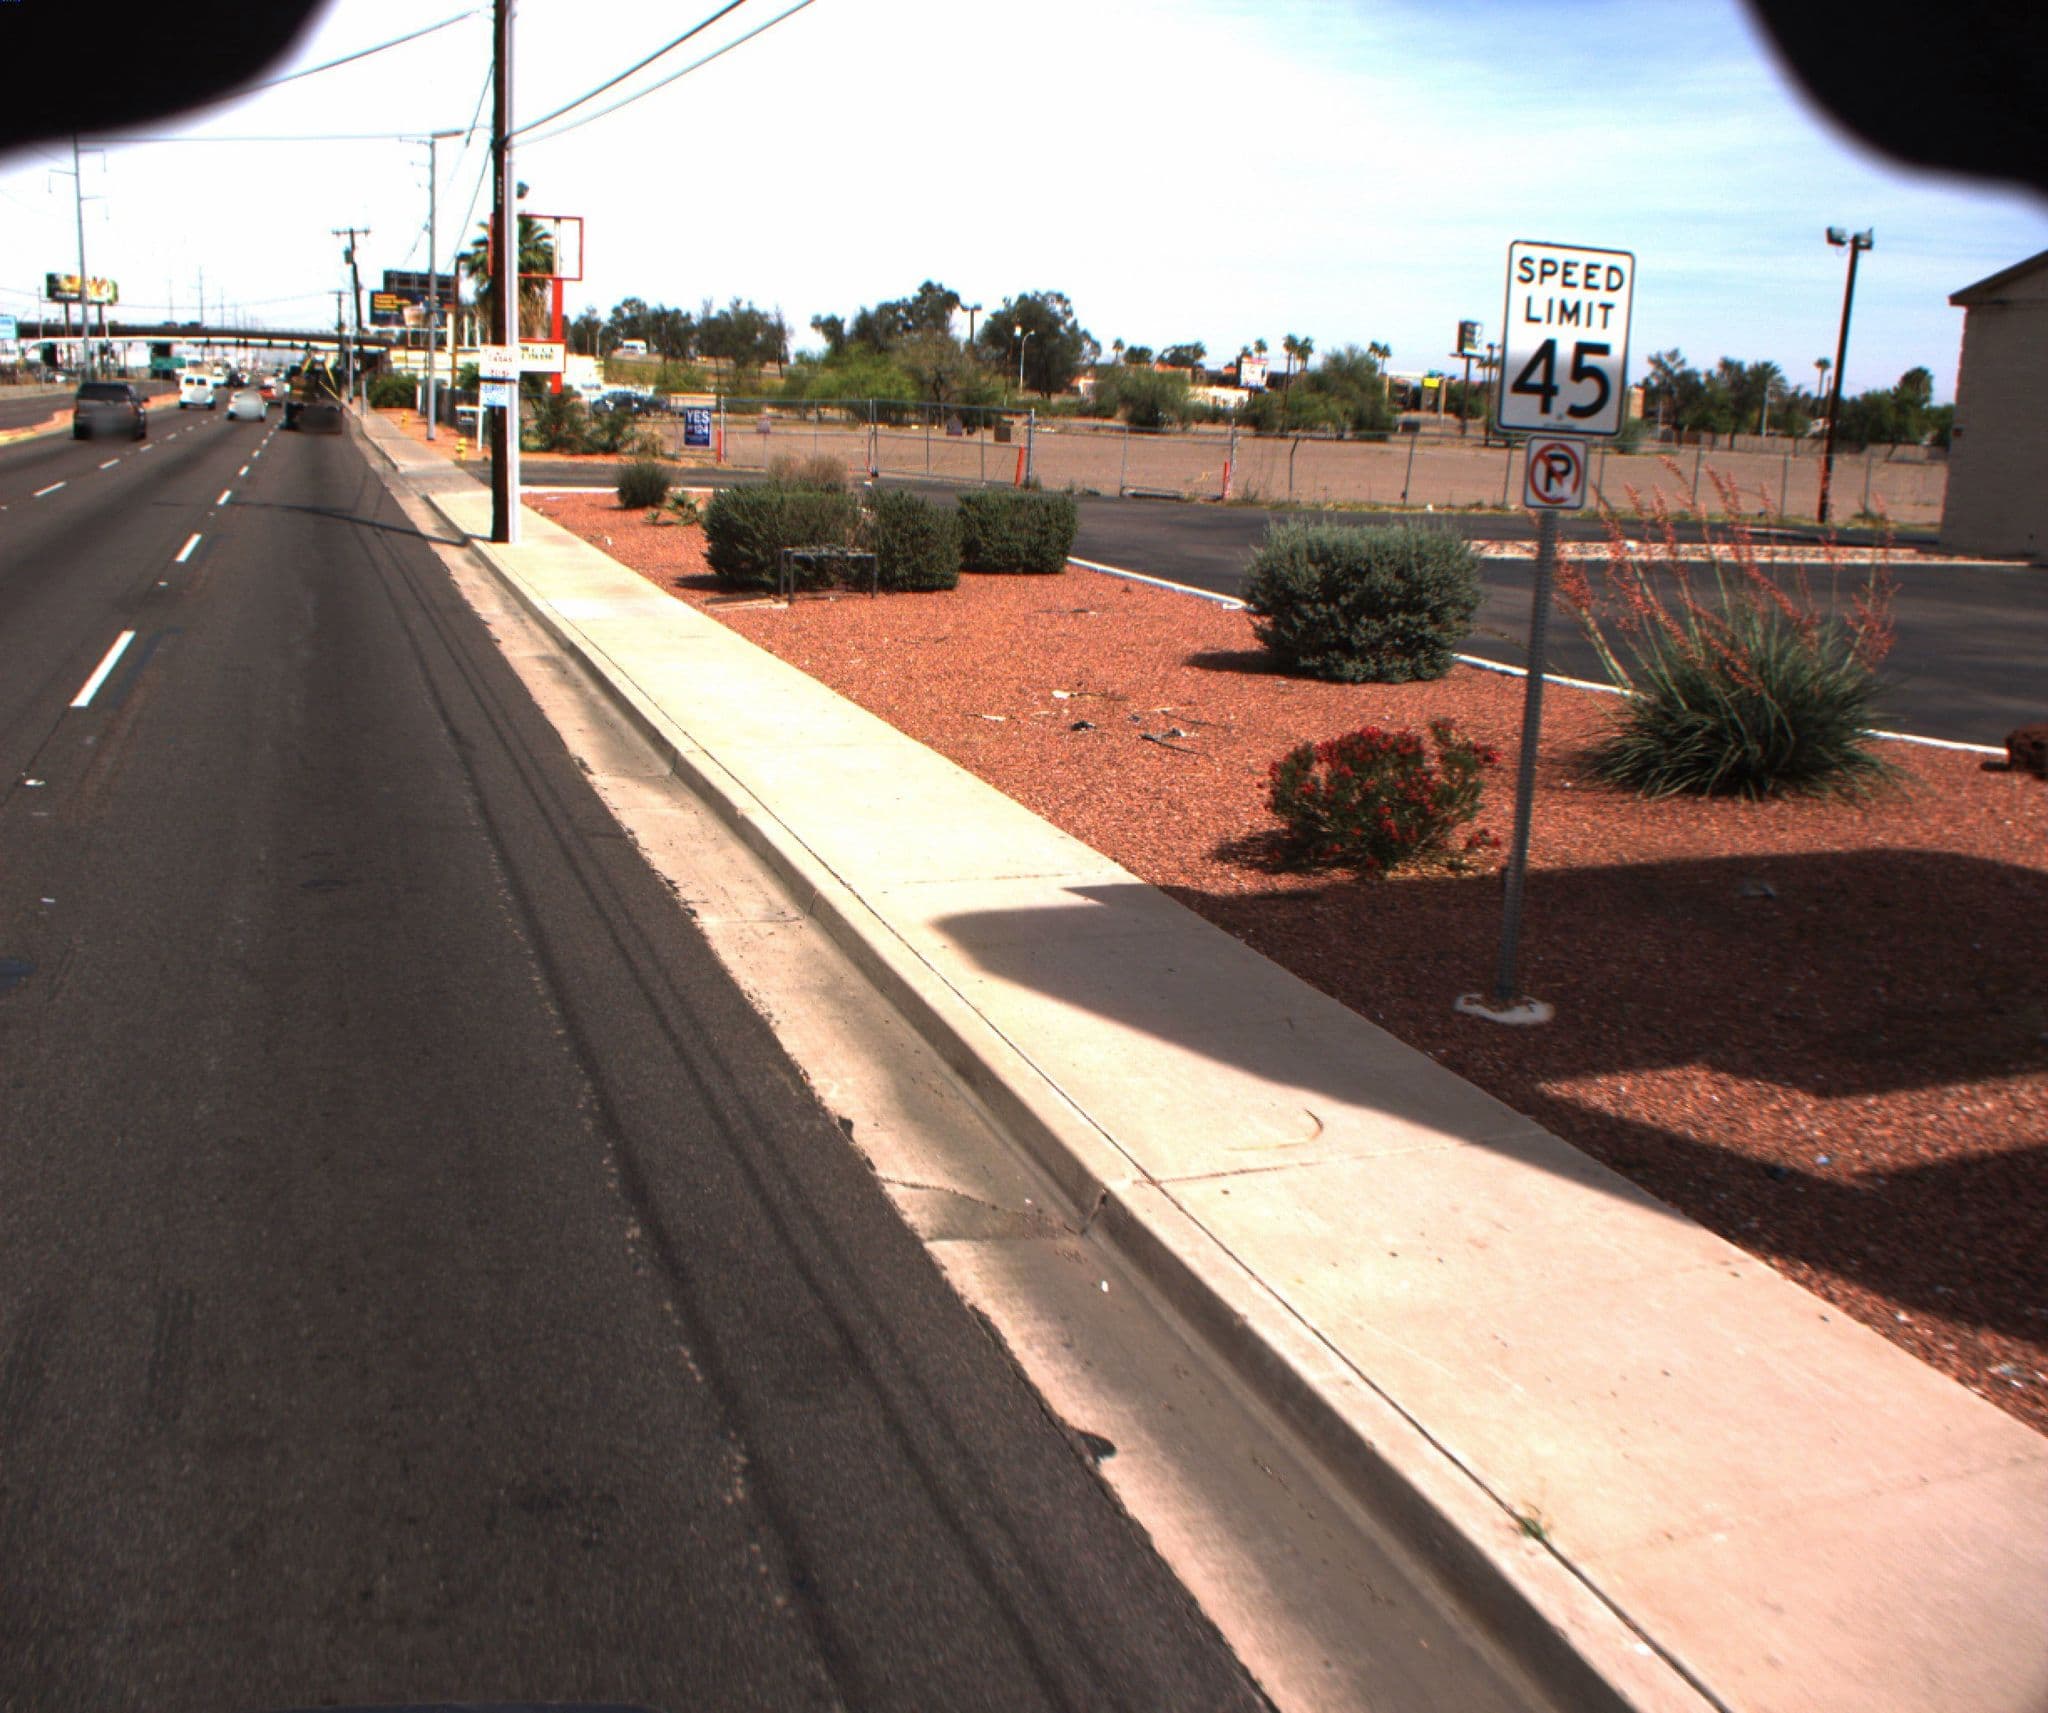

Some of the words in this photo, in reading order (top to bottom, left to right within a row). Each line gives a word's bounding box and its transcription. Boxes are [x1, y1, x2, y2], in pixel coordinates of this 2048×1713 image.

[1516, 256, 1625, 292] SPEED
[1525, 295, 1615, 330] LIMIT
[1511, 339, 1611, 419] 45
[687, 409, 709, 423] YES
[1544, 453, 1573, 492] P
